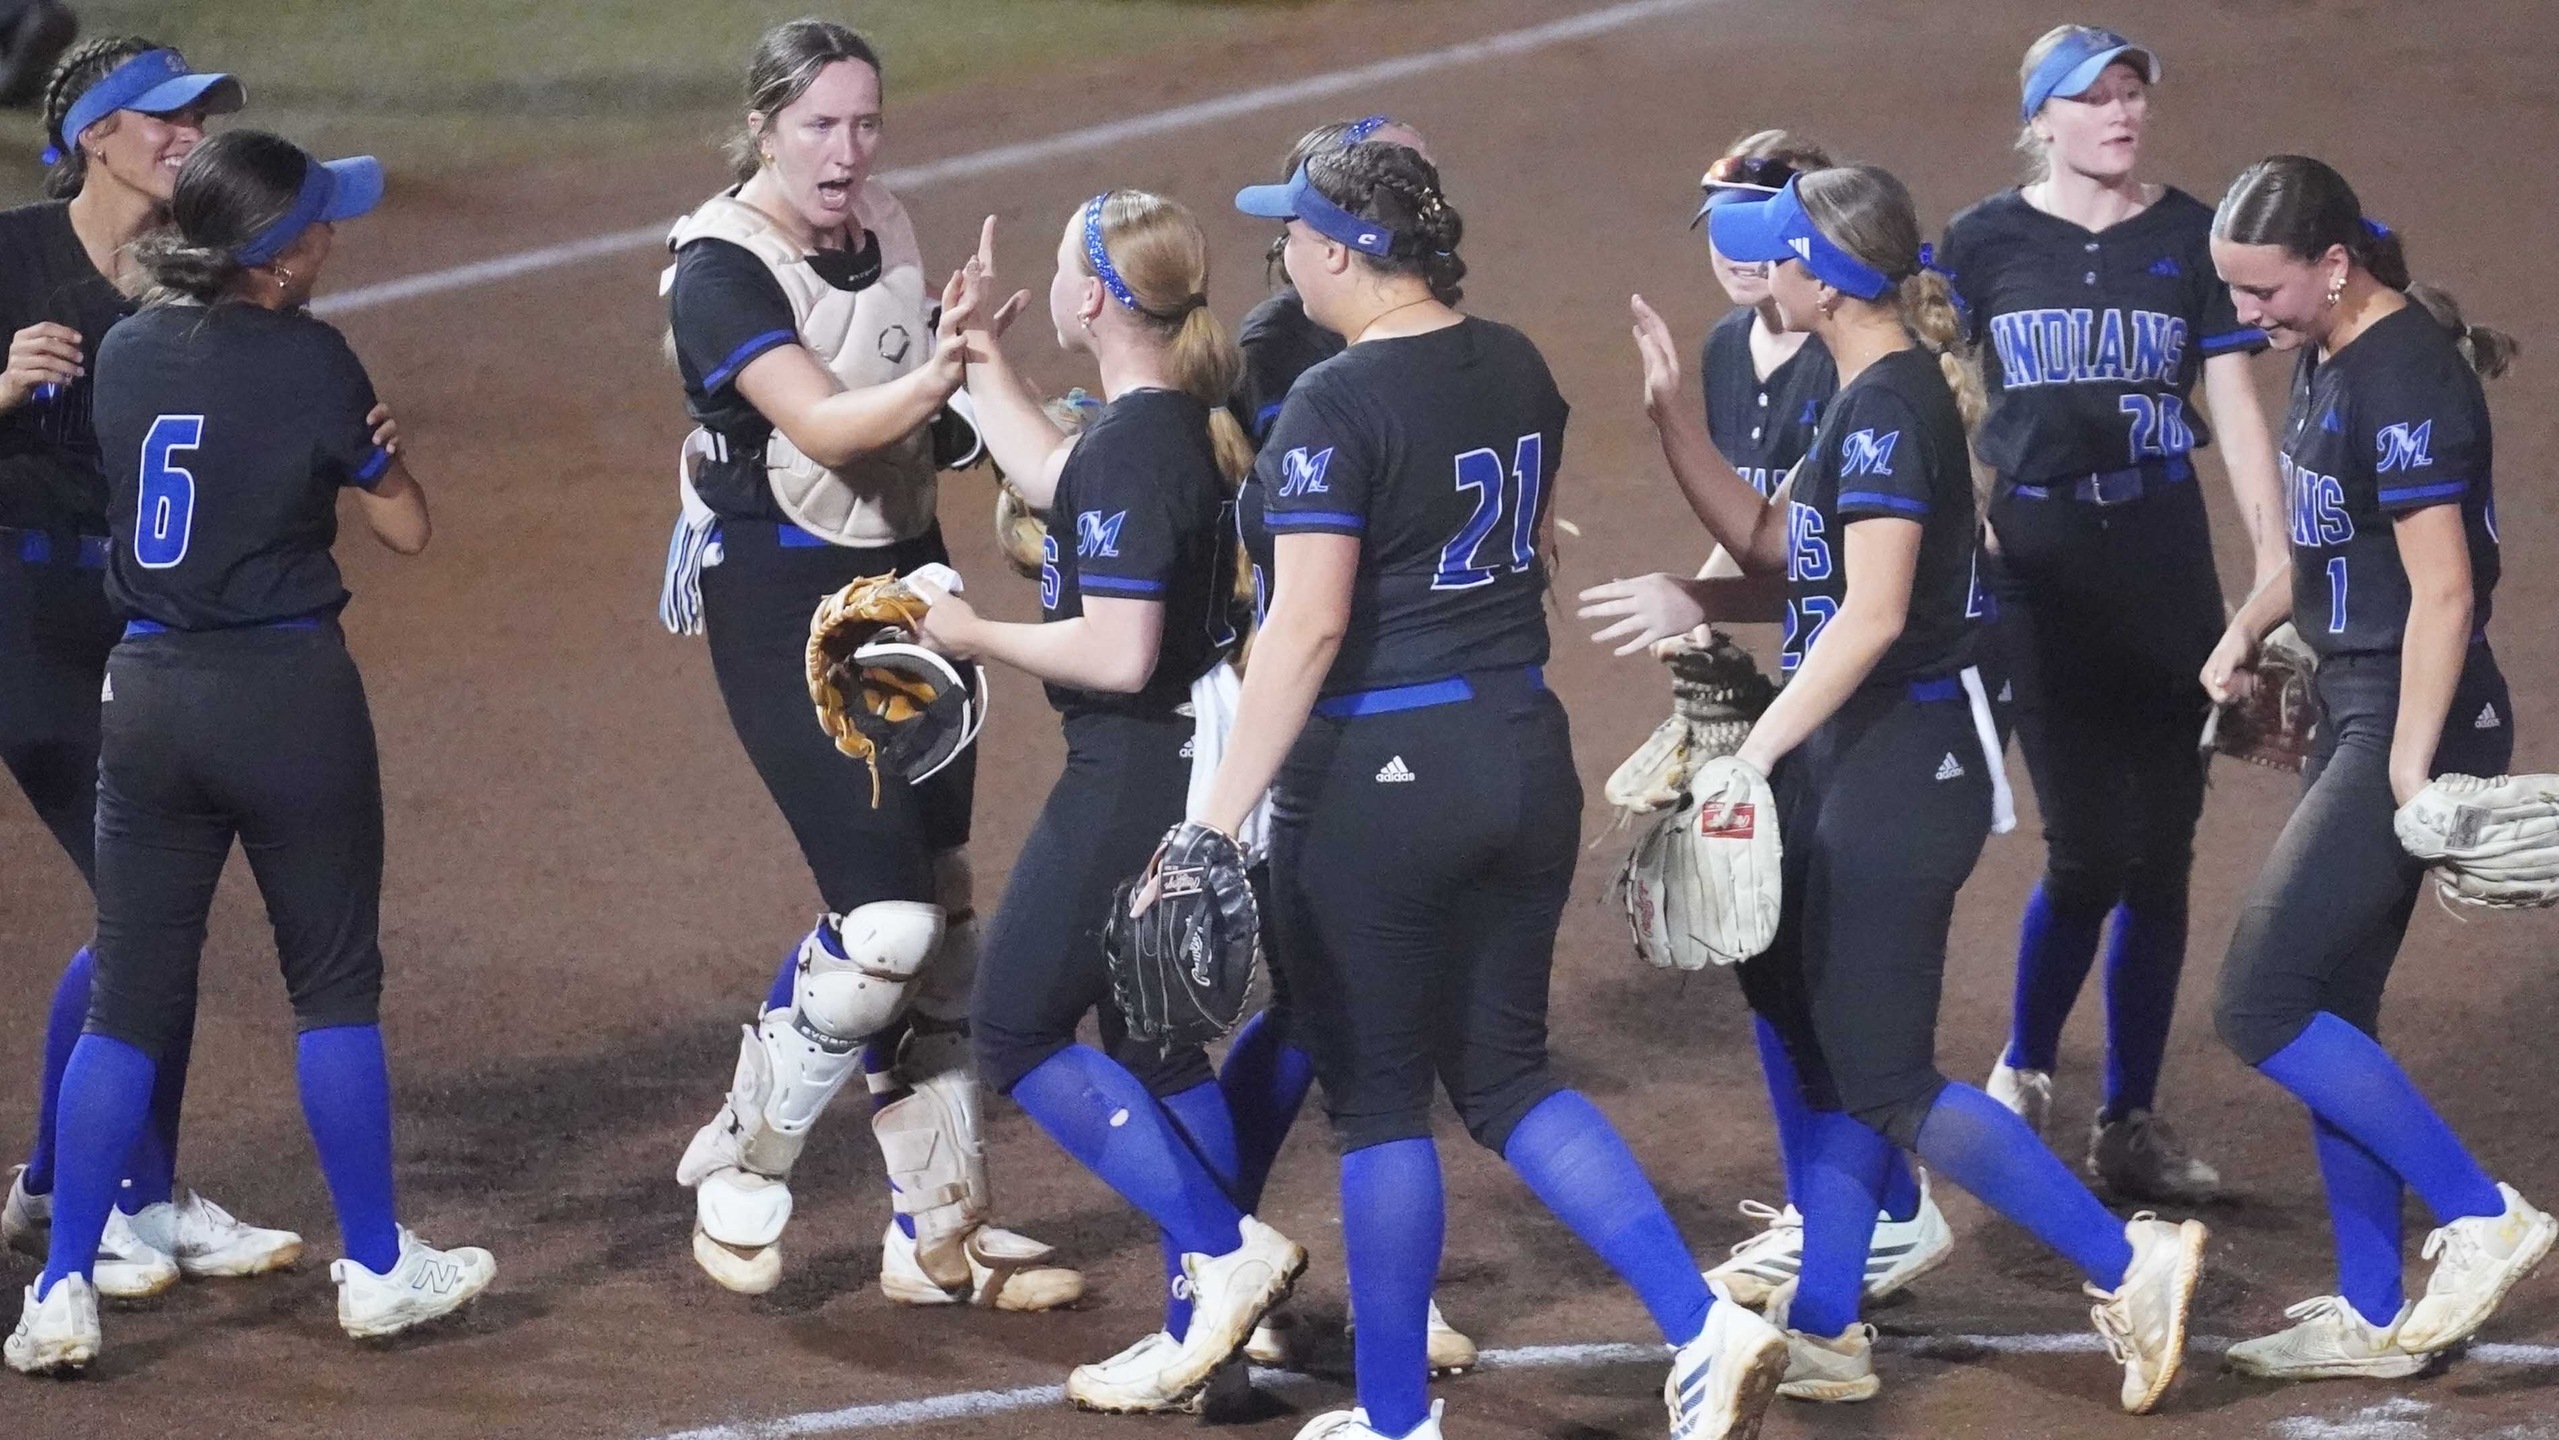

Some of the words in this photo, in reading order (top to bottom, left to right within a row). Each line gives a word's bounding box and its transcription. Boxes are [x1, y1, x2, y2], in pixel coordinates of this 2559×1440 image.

[1990, 308, 2188, 389] INDIANS
[134, 414, 204, 568] 6
[1430, 432, 1541, 590] 21
[2326, 556, 2349, 635] 1
[1375, 772, 1416, 783] adidas
